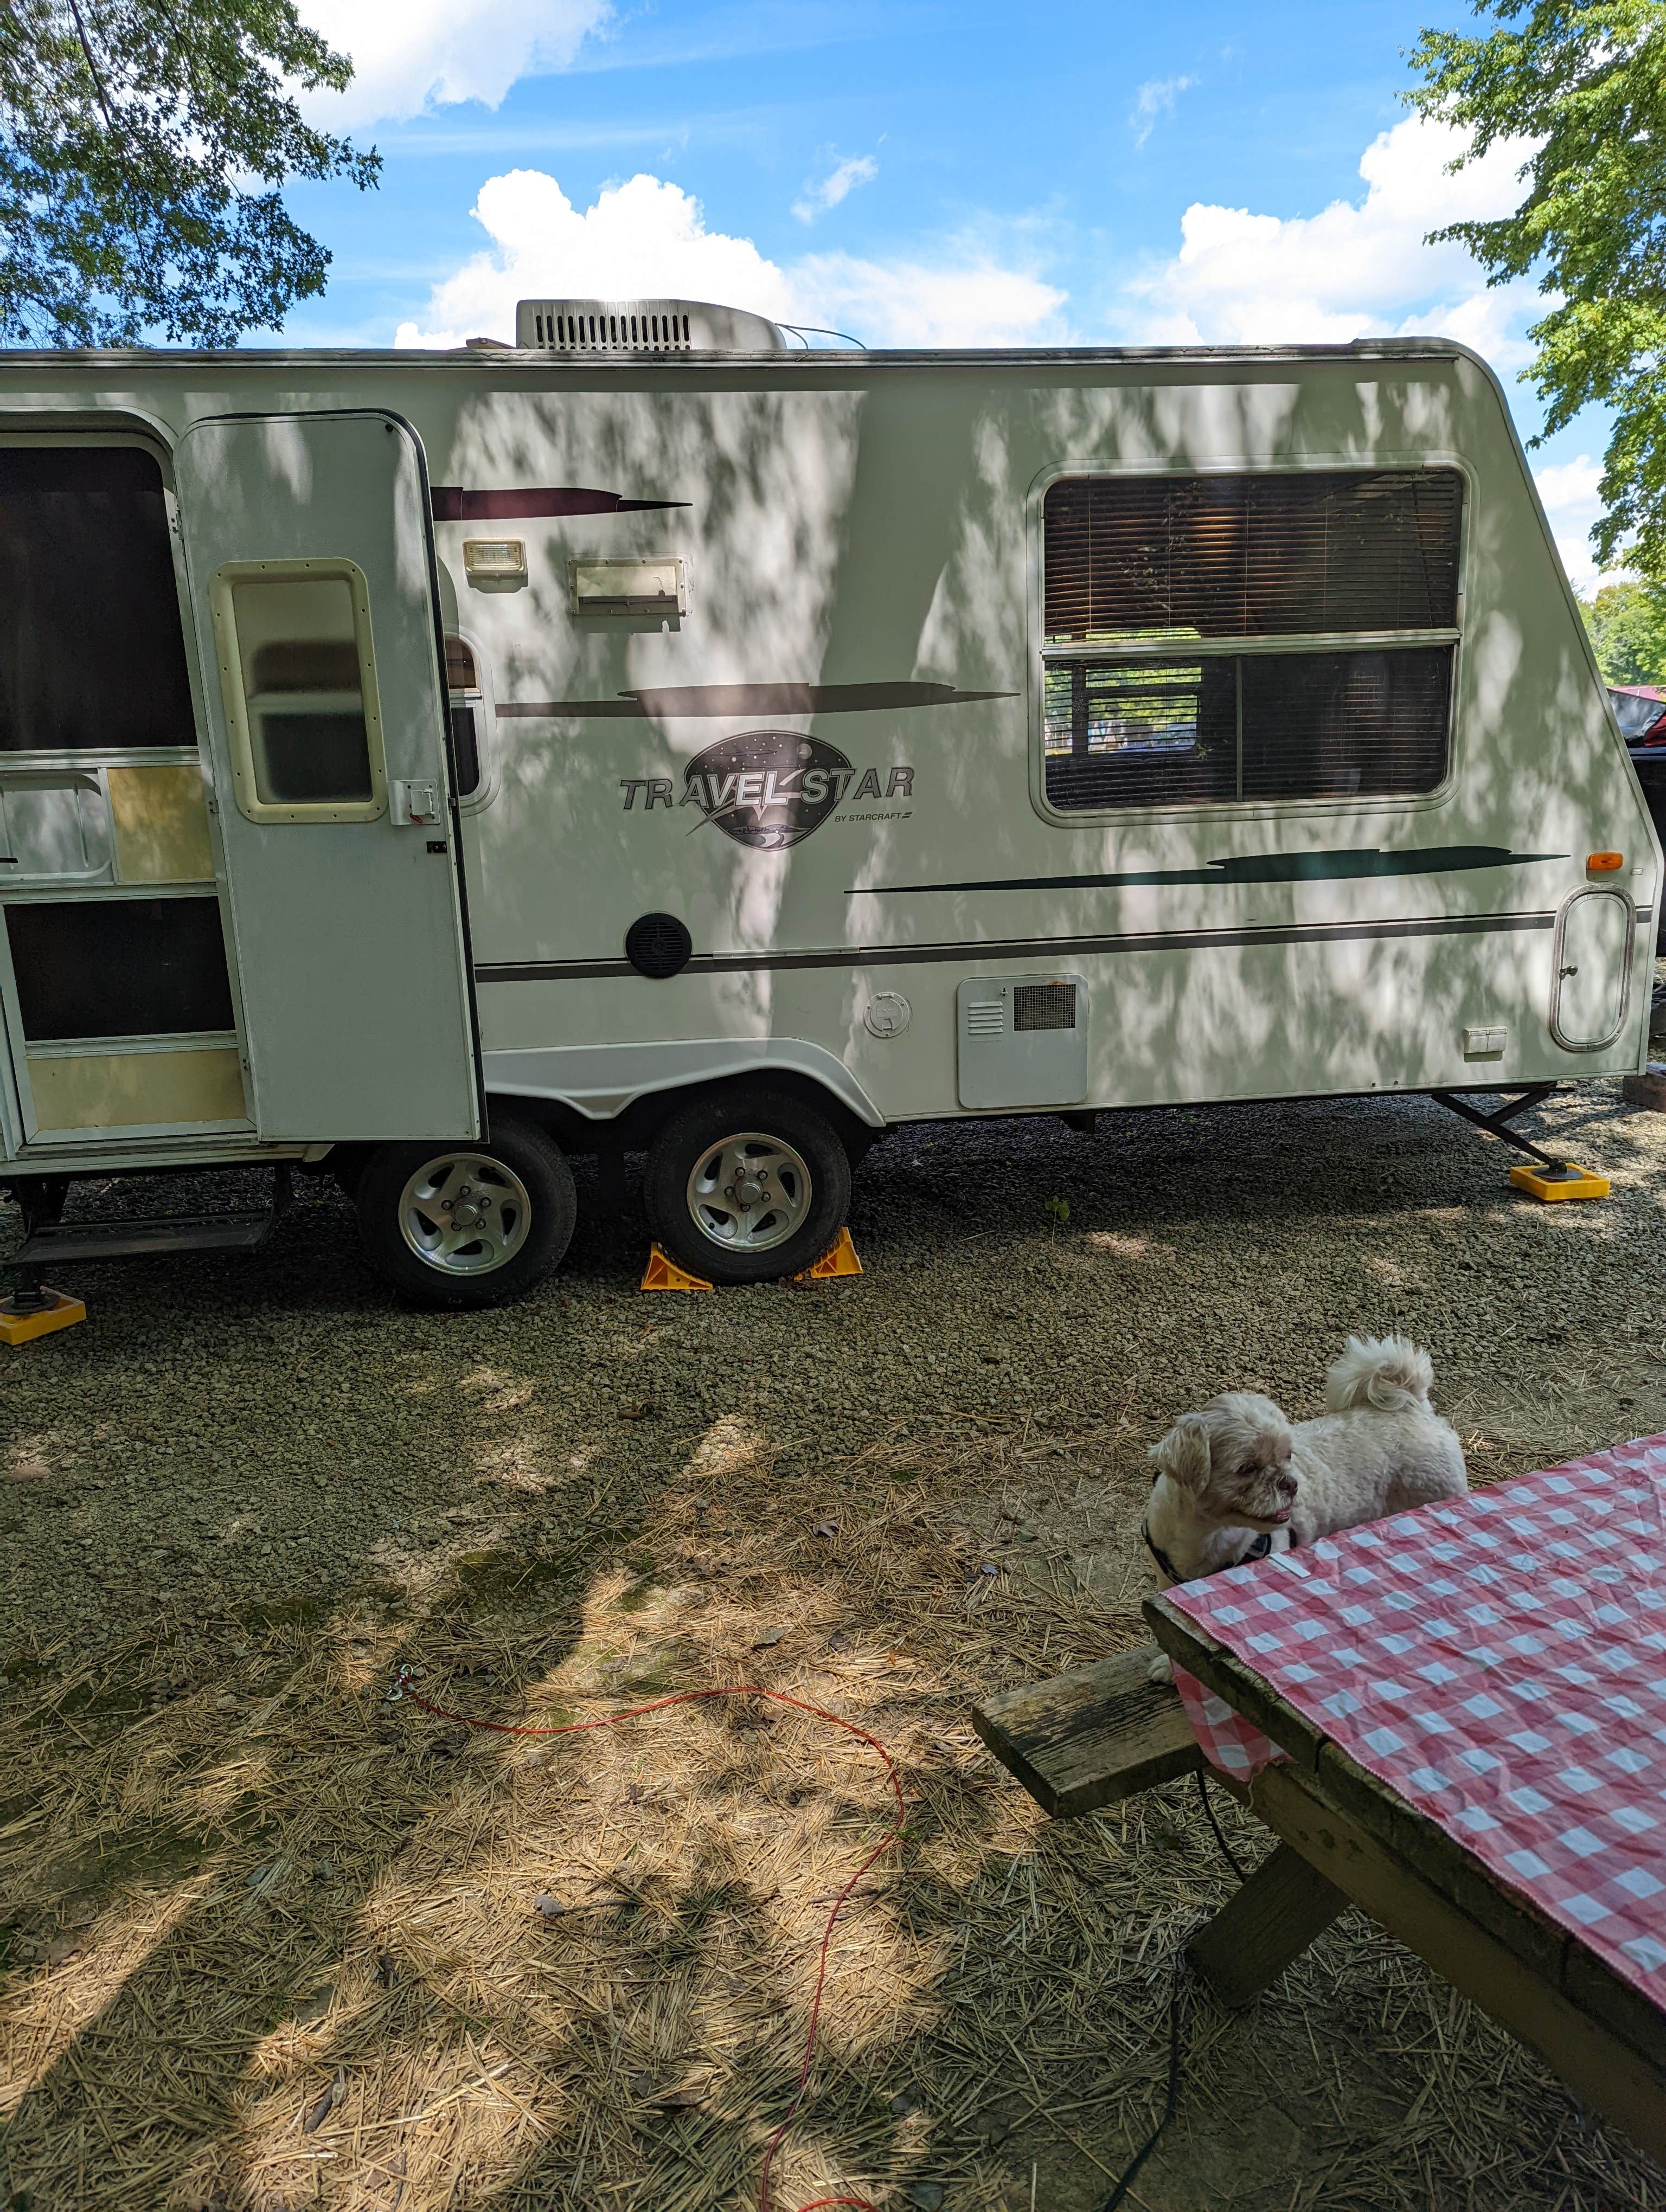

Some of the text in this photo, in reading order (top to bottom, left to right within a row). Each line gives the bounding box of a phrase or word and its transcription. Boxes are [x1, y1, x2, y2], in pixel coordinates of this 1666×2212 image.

[620, 767, 915, 810] TRAVEL STAR
[849, 812, 902, 821] STARCRAFT
